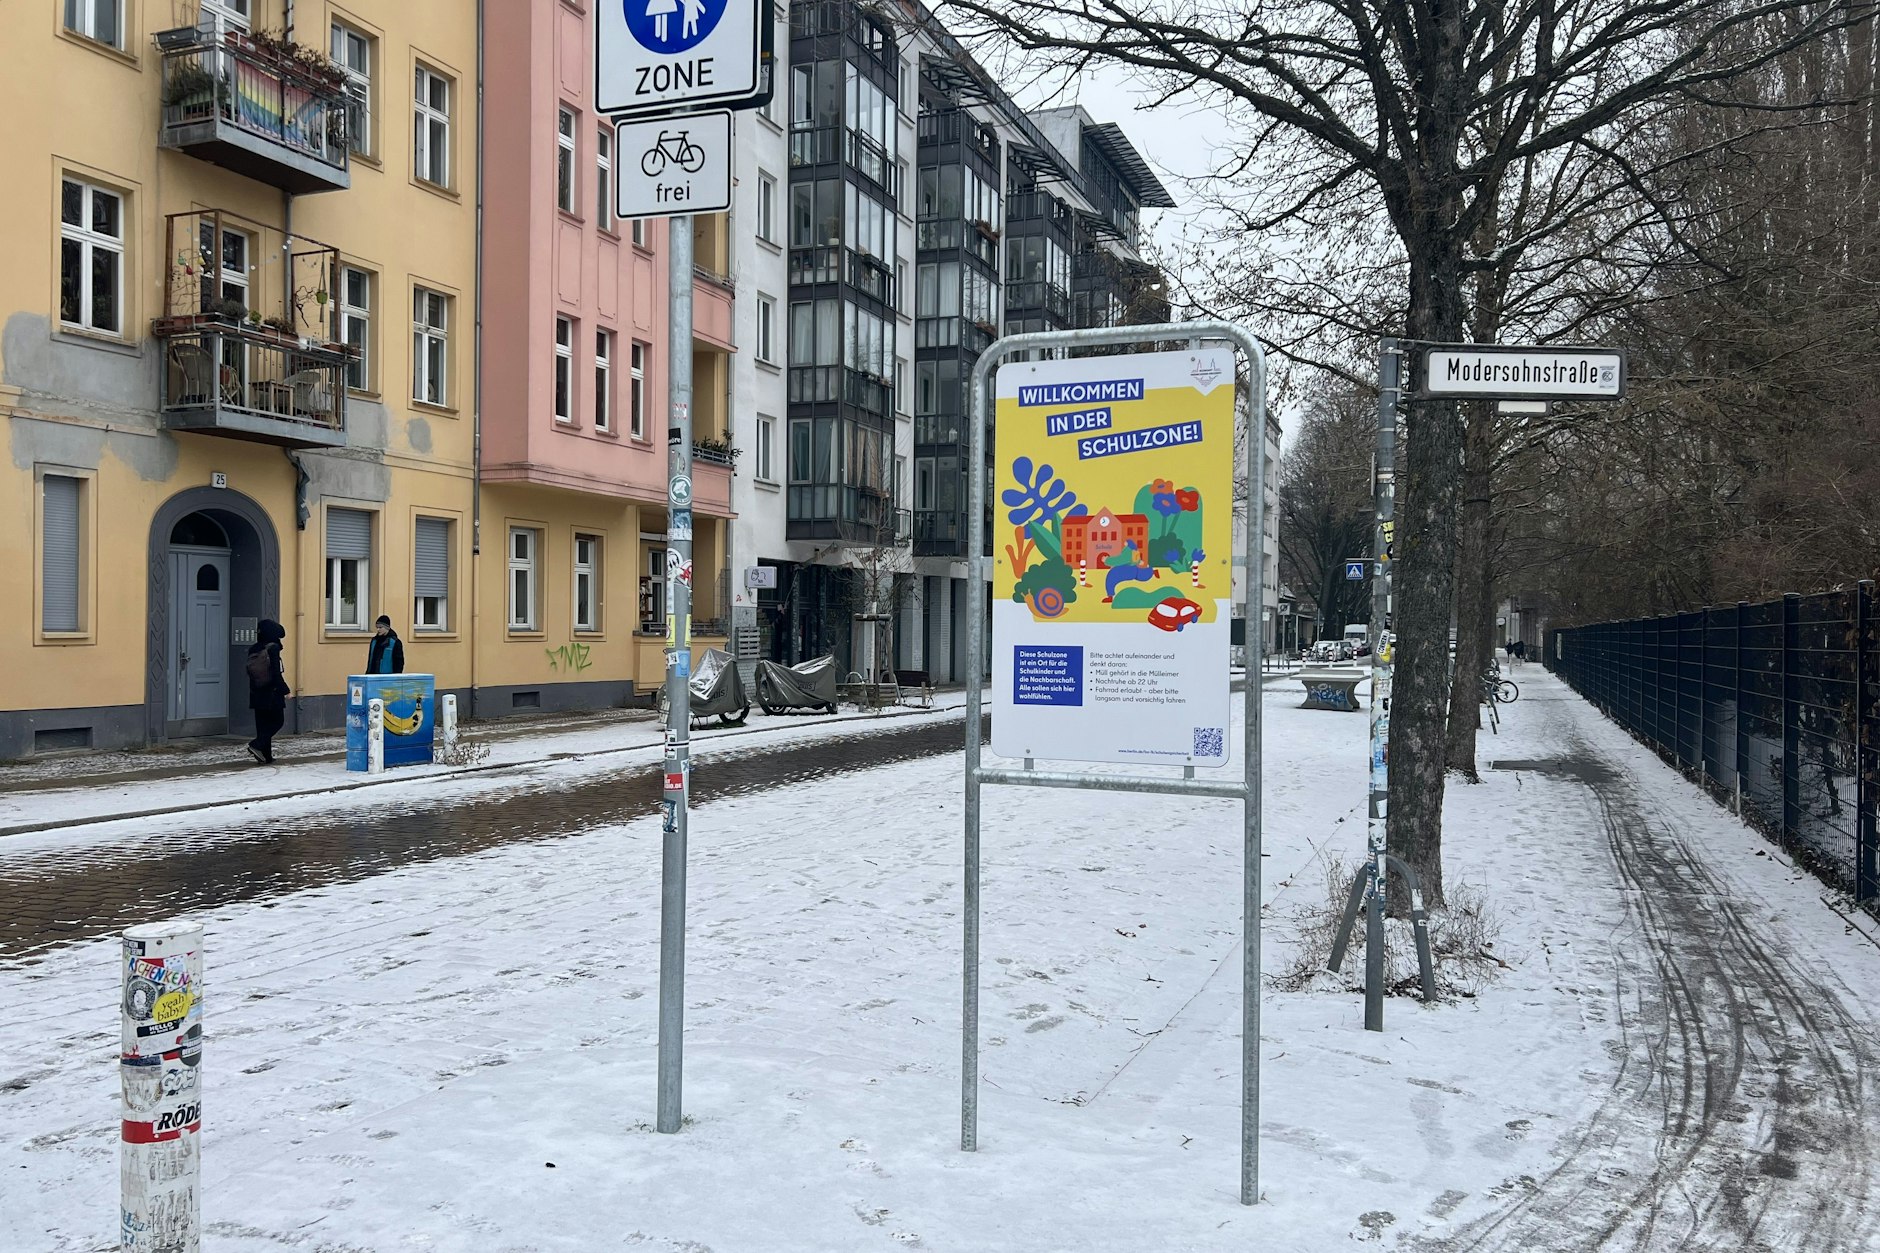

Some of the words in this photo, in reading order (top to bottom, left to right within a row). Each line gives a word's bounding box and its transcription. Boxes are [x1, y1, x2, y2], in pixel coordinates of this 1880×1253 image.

[635, 57, 714, 96] ZONE
[656, 180, 690, 203] frei
[1447, 357, 1598, 384] Modersohnstraße
[1022, 381, 1140, 404] WILLKOMMEN
[1050, 416, 1068, 434] IN
[1073, 411, 1108, 431] DER
[1081, 425, 1199, 457] SCHULZONE!
[216, 474, 225, 485] 25
[1019, 650, 1036, 658] Diese
[1037, 651, 1068, 659] Schulzone
[1095, 695, 1121, 703] langsam
[1135, 696, 1165, 704] vorsichtig
[161, 994, 184, 1012] yeah
[148, 1021, 174, 1032] HELLO
